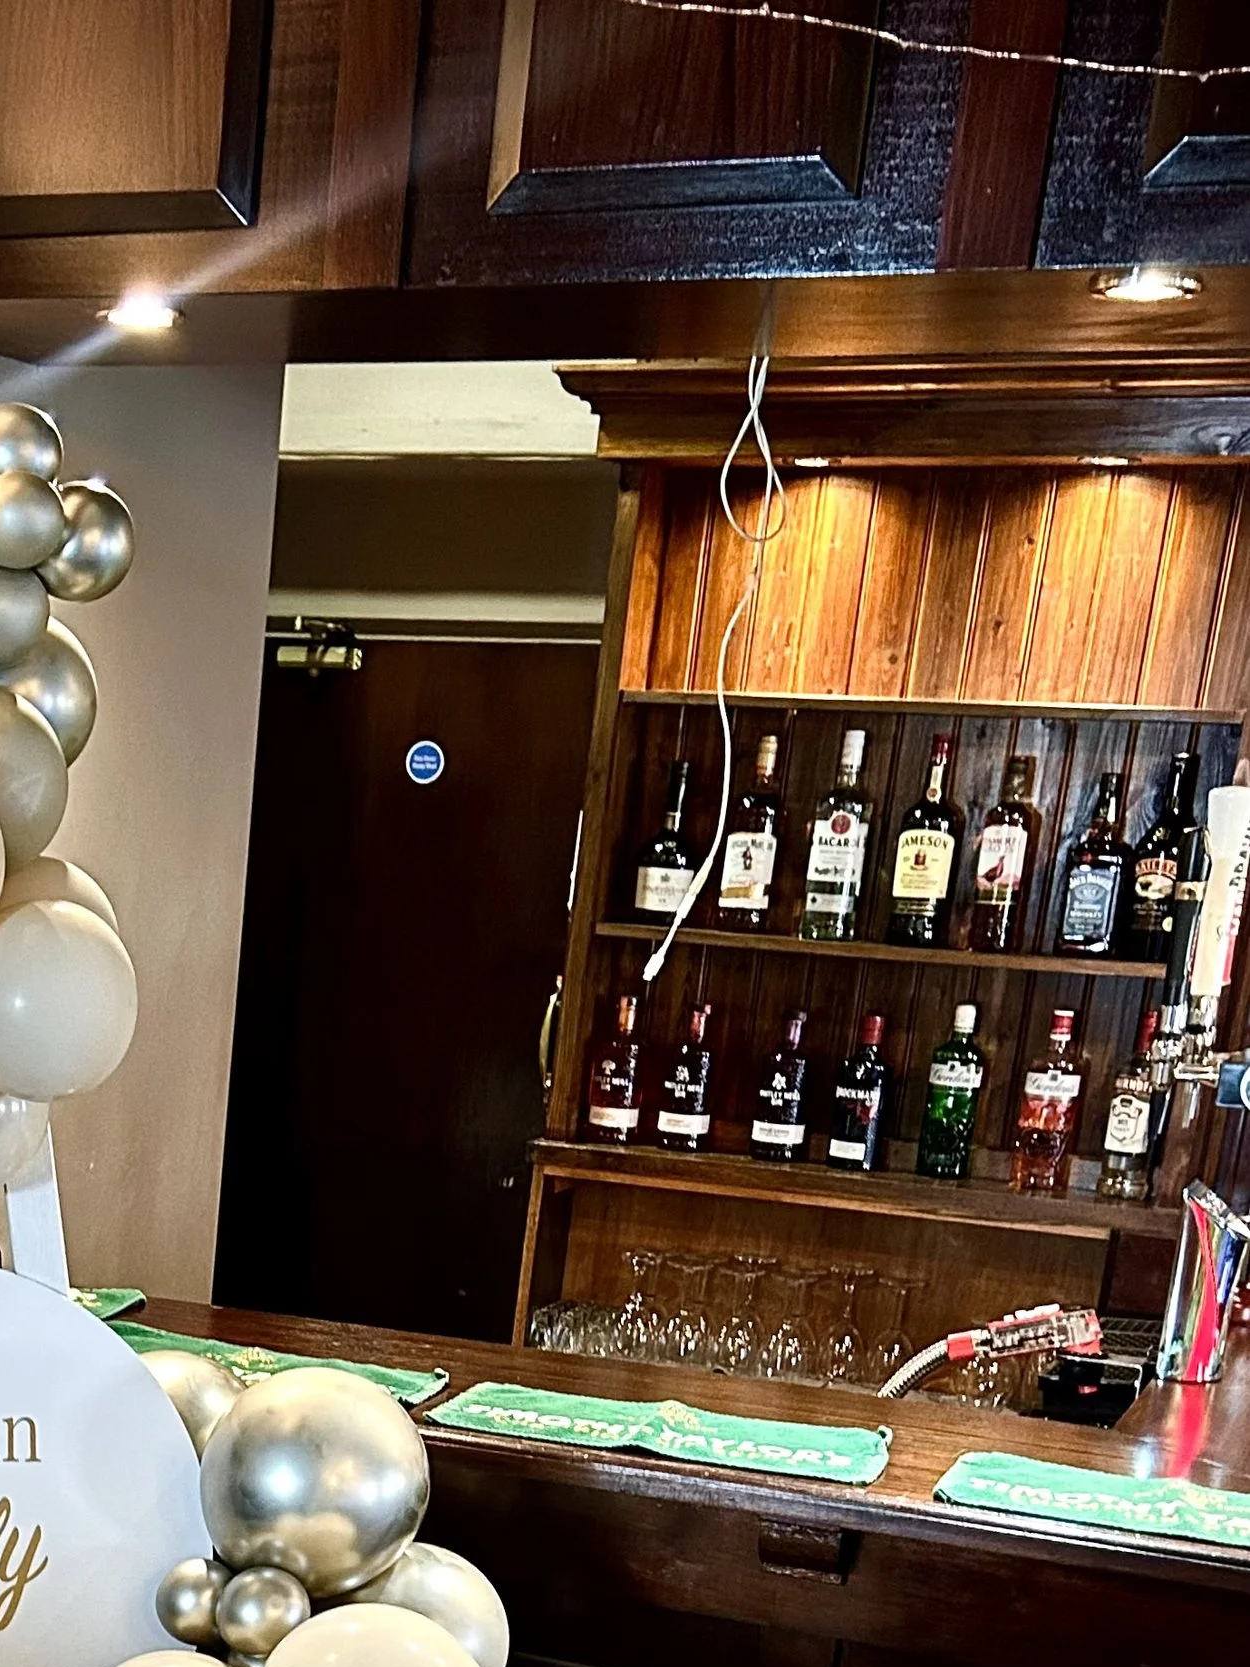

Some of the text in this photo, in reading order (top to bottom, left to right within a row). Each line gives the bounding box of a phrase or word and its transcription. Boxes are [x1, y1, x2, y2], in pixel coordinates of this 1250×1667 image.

[817, 836, 860, 848] BACARI
[901, 835, 949, 850] JAMESON
[1135, 857, 1178, 880] BAILYS
